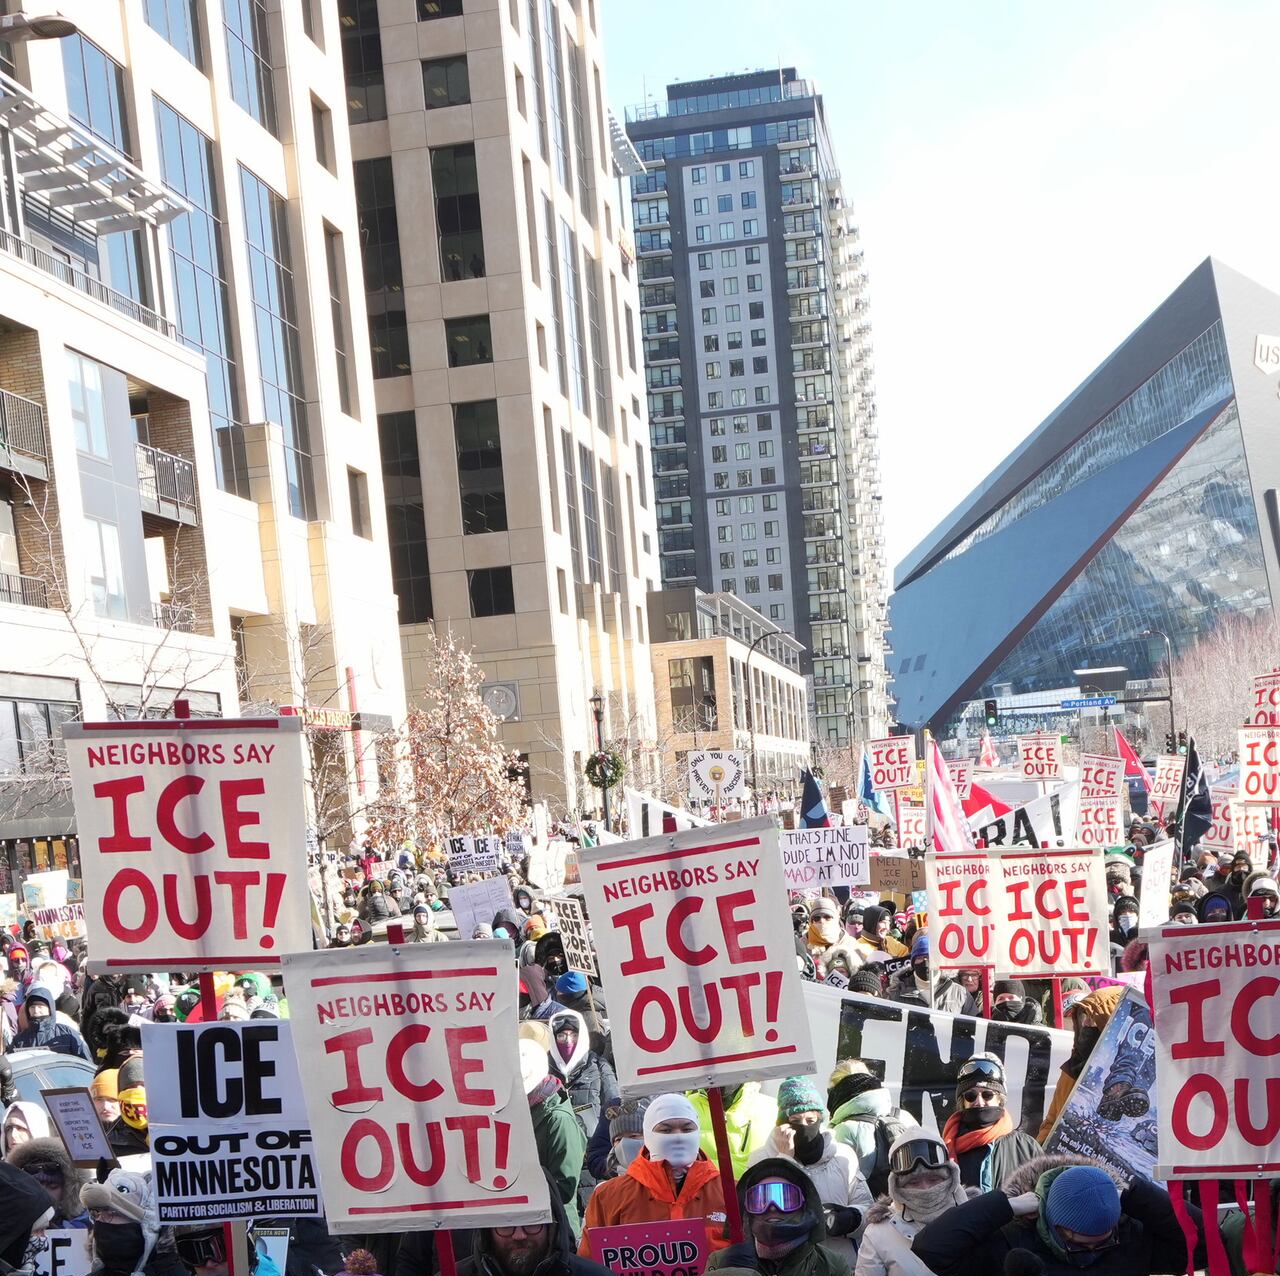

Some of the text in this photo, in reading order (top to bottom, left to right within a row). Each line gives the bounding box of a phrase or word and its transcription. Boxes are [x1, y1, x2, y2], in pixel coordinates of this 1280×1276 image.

[1071, 699, 1101, 707] Portland
[87, 743, 275, 768] NEIGHBORS SAY
[691, 753, 705, 768] ONLY
[728, 754, 741, 767] CAN
[873, 748, 908, 766] ICE
[1023, 747, 1055, 762] ICE
[1024, 763, 1058, 776] OUT!
[1082, 768, 1116, 788] ICE
[1158, 767, 1181, 781] ICE
[94, 775, 270, 859] ICE
[1081, 807, 1116, 825] ICE
[823, 828, 851, 843] FINE
[784, 843, 866, 864] DUDE NOT
[603, 858, 759, 902] NEIGHBORS SAY
[784, 863, 859, 882] MAD AT YOU
[1003, 862, 1092, 878] NEIGHBORS SAY
[102, 869, 287, 949] OUT!
[1006, 879, 1090, 921] ICE
[560, 918, 582, 936] OUT
[612, 889, 767, 977] ICE
[1009, 927, 1099, 968] OUT!
[566, 951, 591, 970] MPLS
[317, 992, 495, 1024] NEIGHBORS SAY
[628, 972, 783, 1053] OUT!
[176, 1027, 284, 1119] ICE
[323, 1024, 495, 1111] ICE
[154, 1130, 312, 1156] OUT OF
[339, 1116, 510, 1193] OUT!
[156, 1154, 316, 1197] MINNESOTA
[161, 1198, 314, 1218] PARTY FOR SOCIALISM & LIBERATION
[602, 1240, 699, 1270] PROUD
